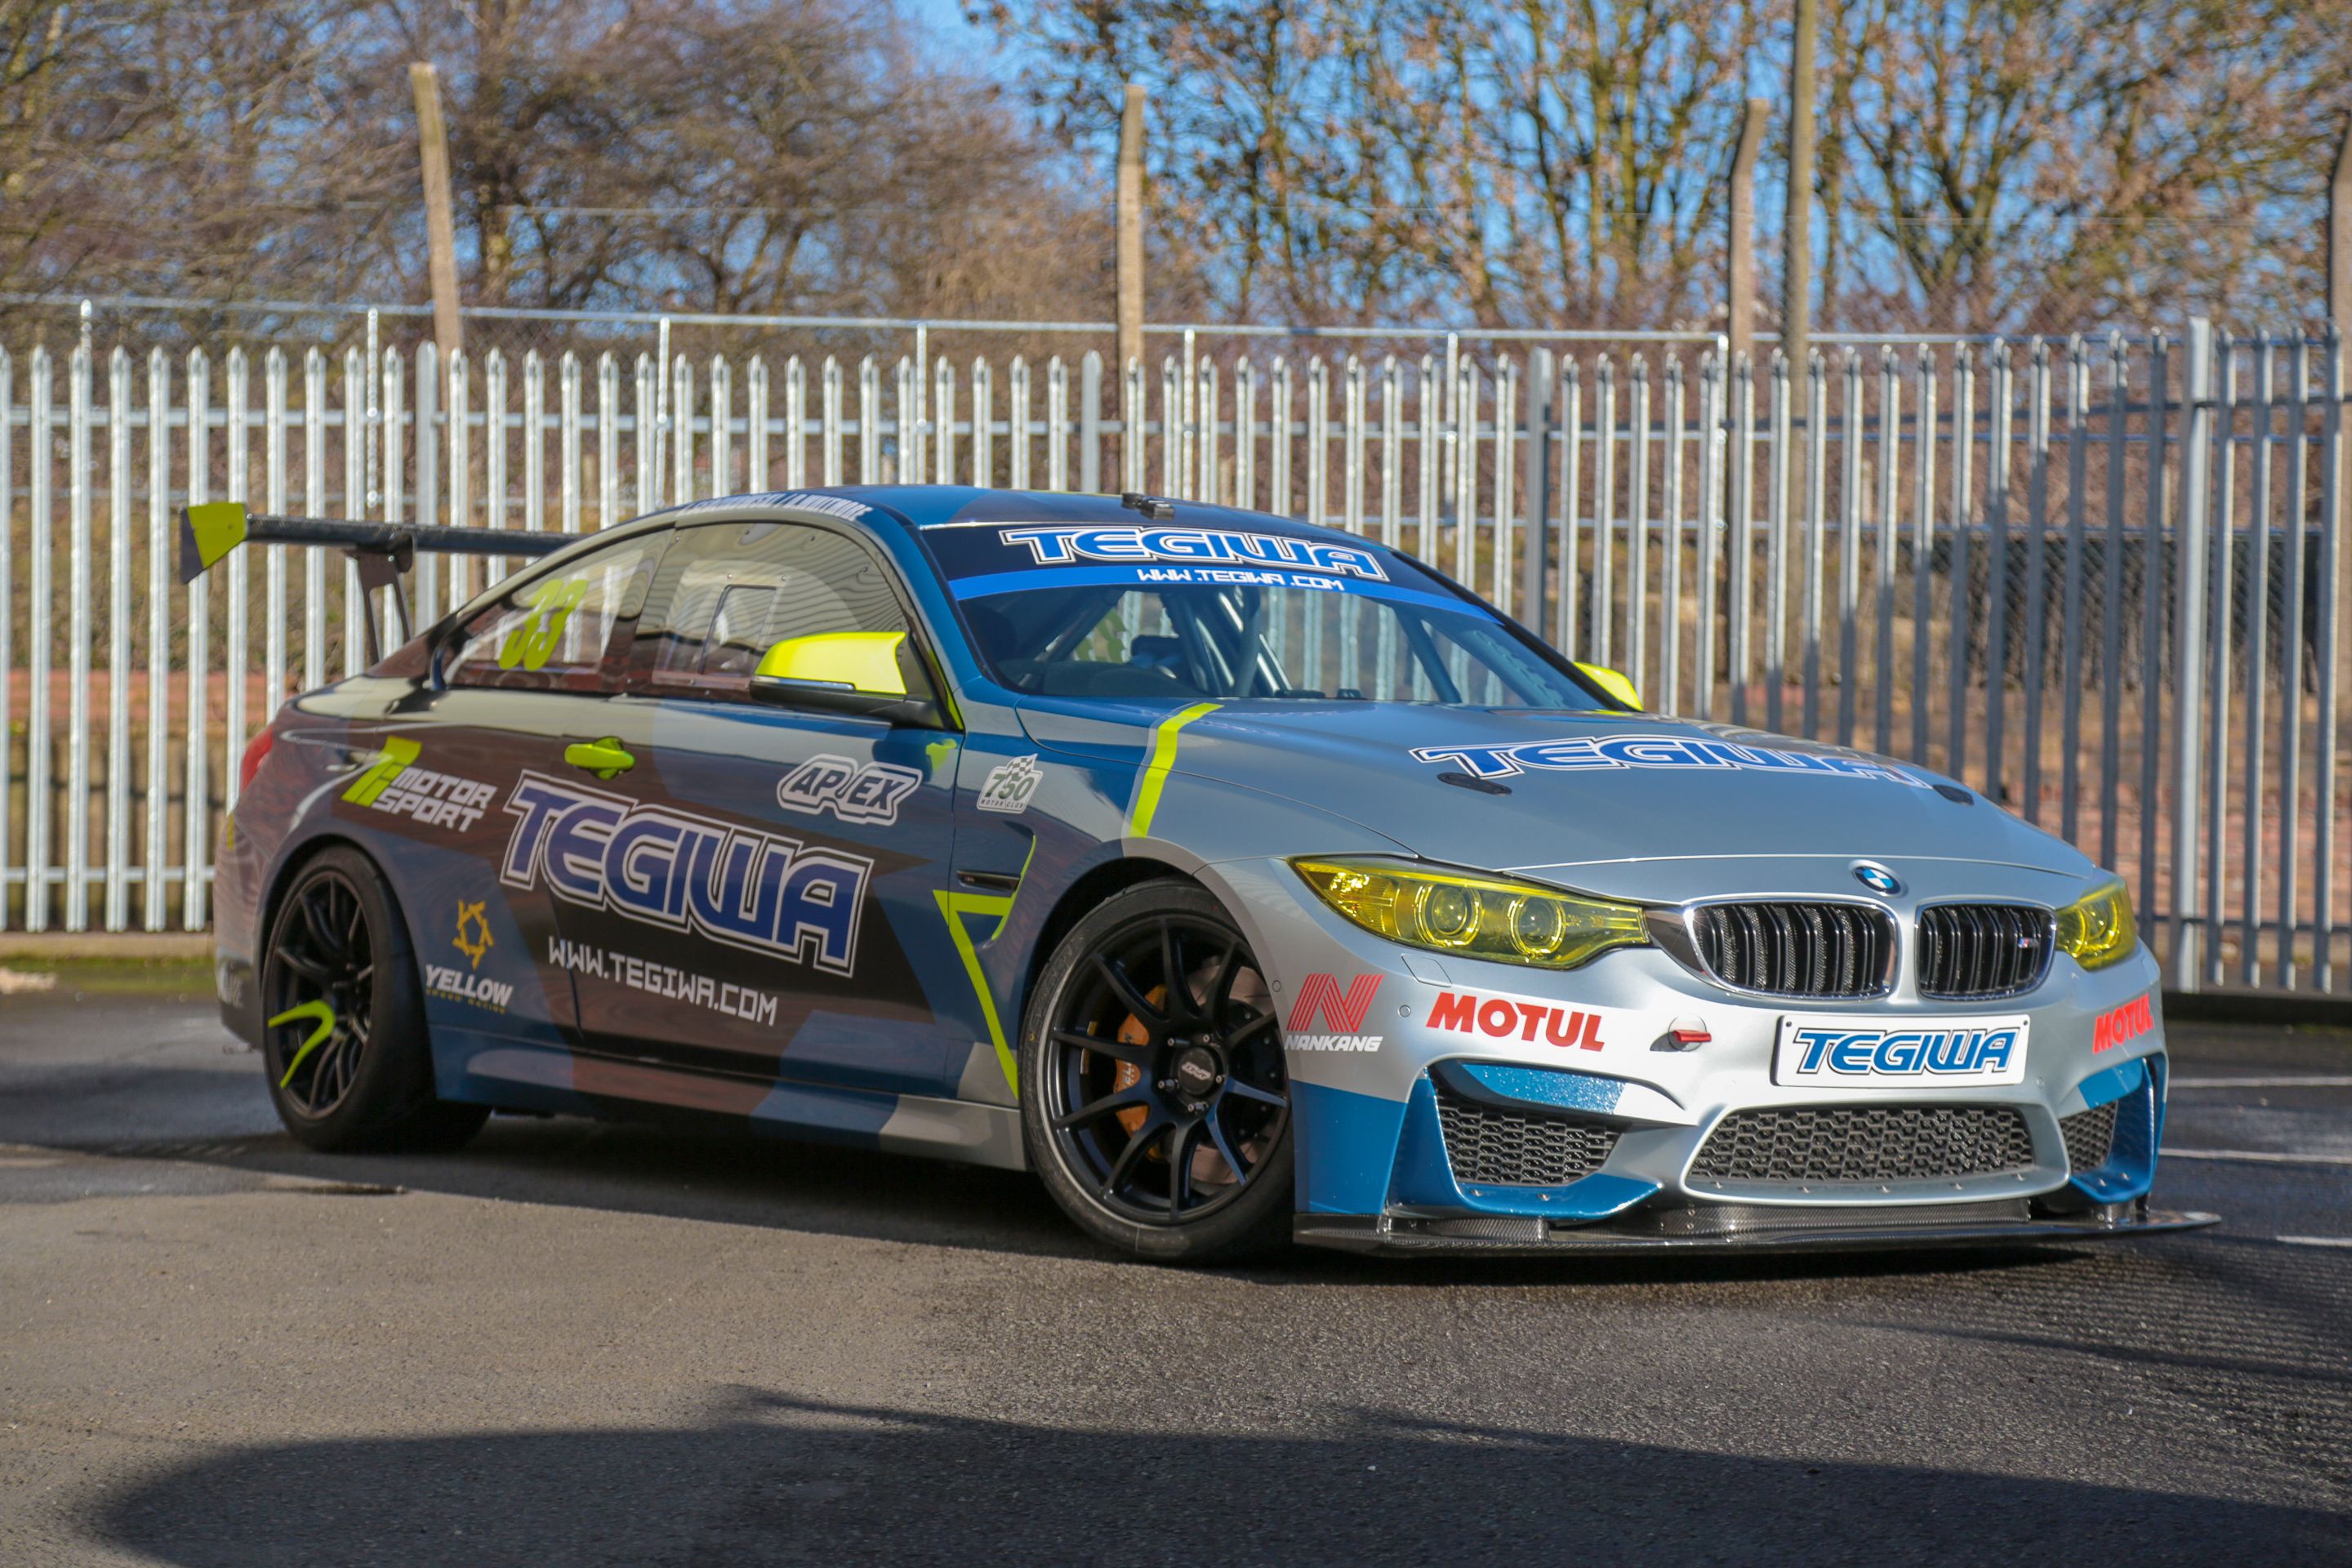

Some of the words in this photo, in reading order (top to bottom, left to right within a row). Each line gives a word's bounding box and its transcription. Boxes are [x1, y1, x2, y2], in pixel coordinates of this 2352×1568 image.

[999, 526, 1389, 581] TEGIWA
[499, 578, 588, 671] 33
[390, 766, 498, 810] MOTOR
[782, 760, 915, 818] APEX
[985, 773, 1035, 801] 750
[1409, 734, 1933, 789] TEGIWA
[371, 787, 485, 833] SPORT
[500, 769, 874, 978] TEGIWA
[425, 964, 514, 1007] YELLOW
[548, 936, 778, 1026] WWW.TEGIWA.COM
[1285, 1034, 1384, 1054] NANKANG
[1426, 991, 1606, 1052] MOTUL
[2092, 992, 2154, 1054] MOTUL
[1793, 1027, 2021, 1076] TEGIWA
